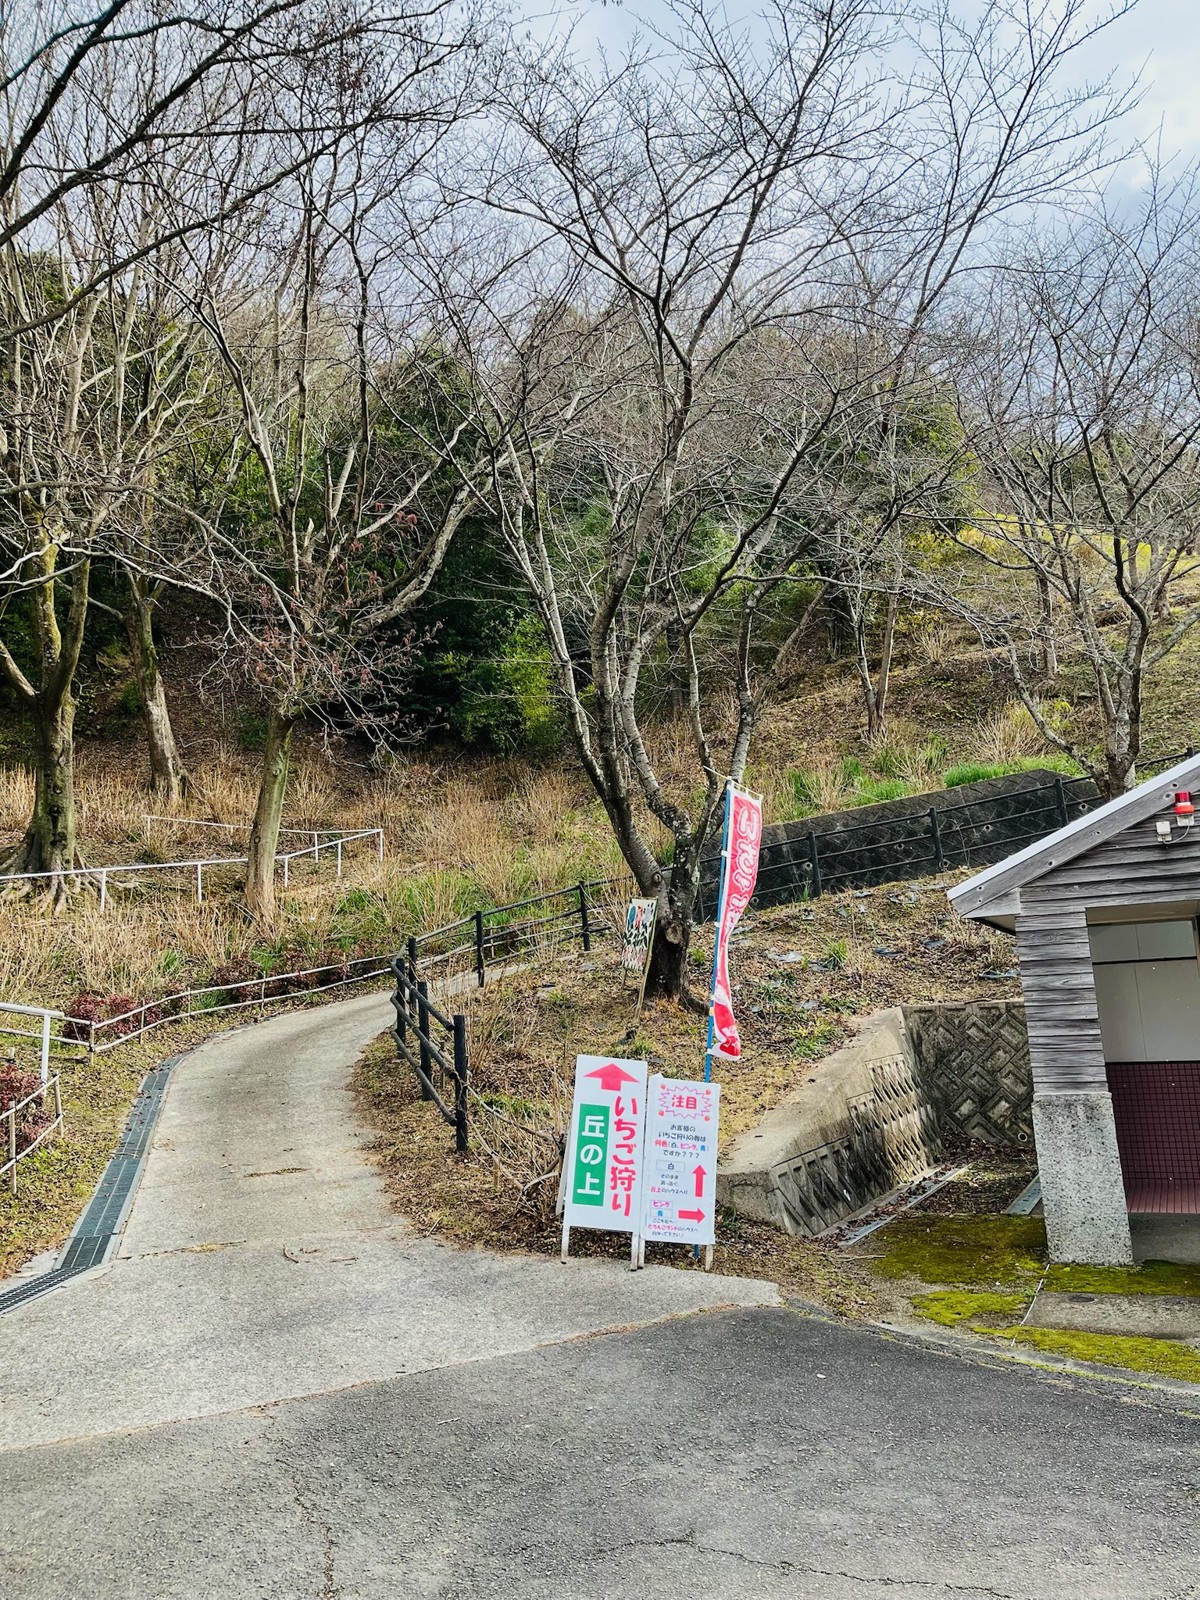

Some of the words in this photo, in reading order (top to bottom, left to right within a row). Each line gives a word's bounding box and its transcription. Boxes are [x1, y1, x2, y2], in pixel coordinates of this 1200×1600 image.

[671, 1094, 697, 1110] 注目
[670, 1124, 696, 1133] お客様の
[576, 1115, 605, 1196] 丘の上
[610, 1095, 638, 1217] いちご狩り
[667, 1162, 675, 1170] 白
[653, 1200, 670, 1208] ピンク
